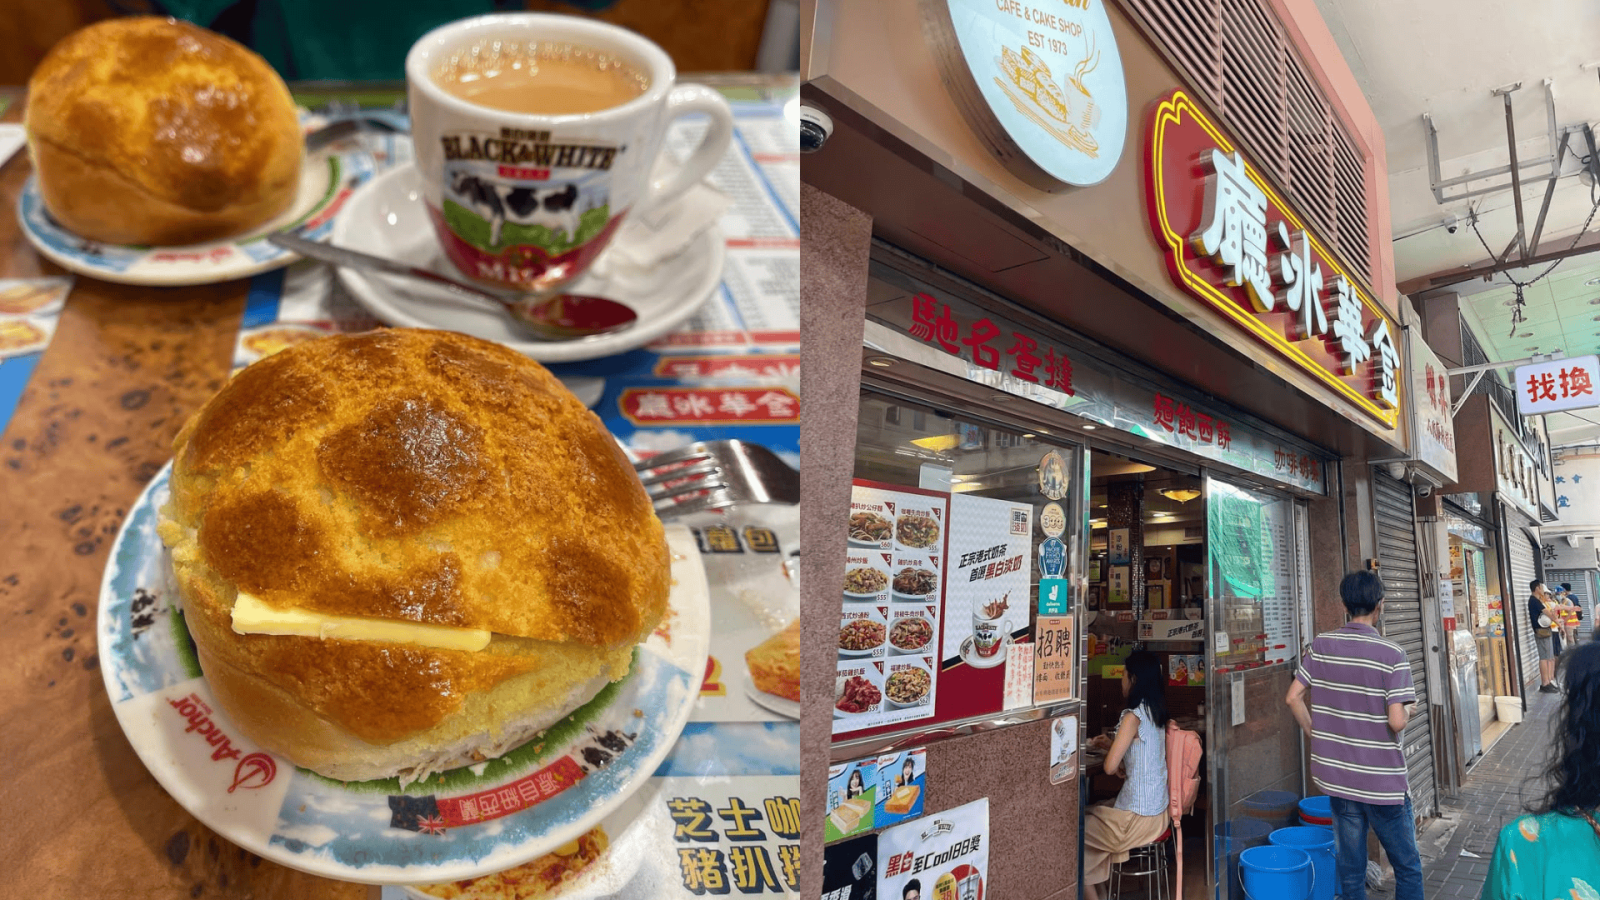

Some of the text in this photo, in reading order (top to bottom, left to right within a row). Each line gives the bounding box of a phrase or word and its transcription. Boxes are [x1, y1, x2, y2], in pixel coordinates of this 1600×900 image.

[996, 0, 1082, 37] CAFE & CAKE SHOP
[1027, 30, 1068, 56] EST 1973
[908, 292, 1075, 397] 馳名蛋撻
[1526, 366, 1593, 403] 找換
[890, 503, 895, 511] 2
[936, 509, 940, 517] 3
[690, 525, 781, 553] 蘿包
[886, 554, 891, 563] 5
[933, 557, 938, 565] 6
[882, 608, 887, 616] 8
[931, 607, 935, 615] 9
[1037, 627, 1071, 659] 招聘
[168, 695, 242, 761] Anchor
[460, 772, 560, 822] 源自紐西蘭
